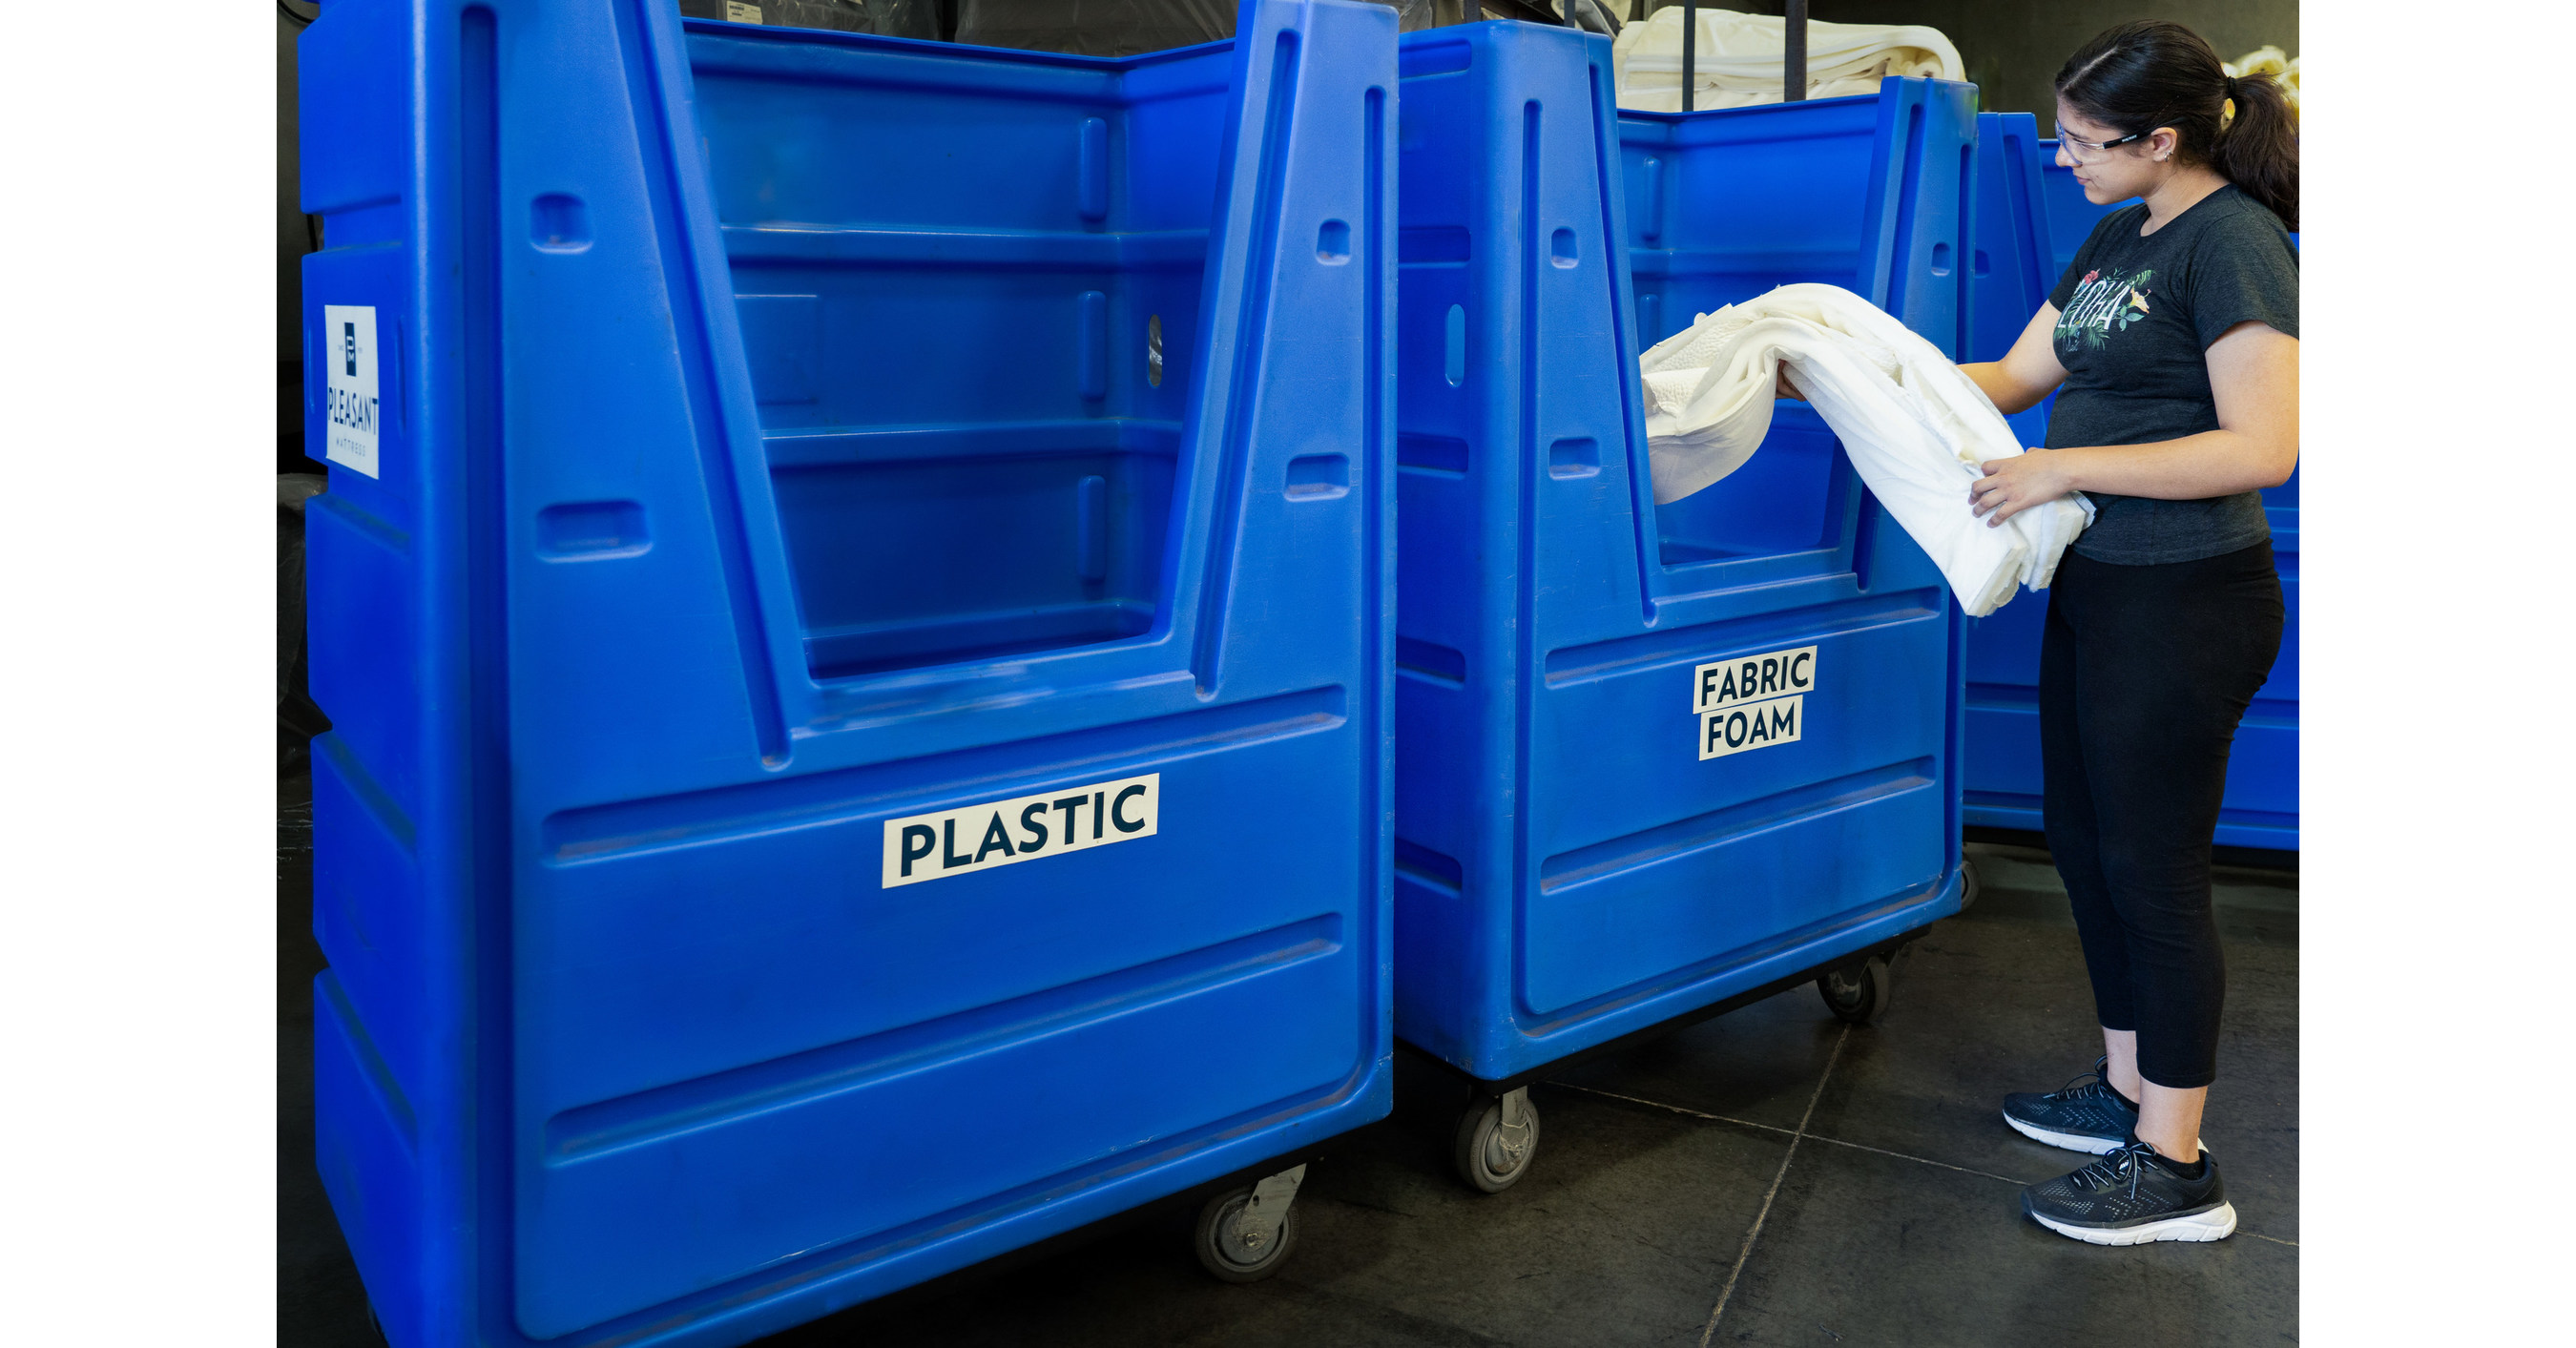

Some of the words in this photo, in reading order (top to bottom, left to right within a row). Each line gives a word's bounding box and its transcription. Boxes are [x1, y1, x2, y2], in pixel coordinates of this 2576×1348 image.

[328, 387, 379, 435] PLEASANT
[1701, 653, 1811, 707] FABRIC
[1708, 701, 1795, 753] FOAM
[901, 784, 1147, 878] PLASTIC
